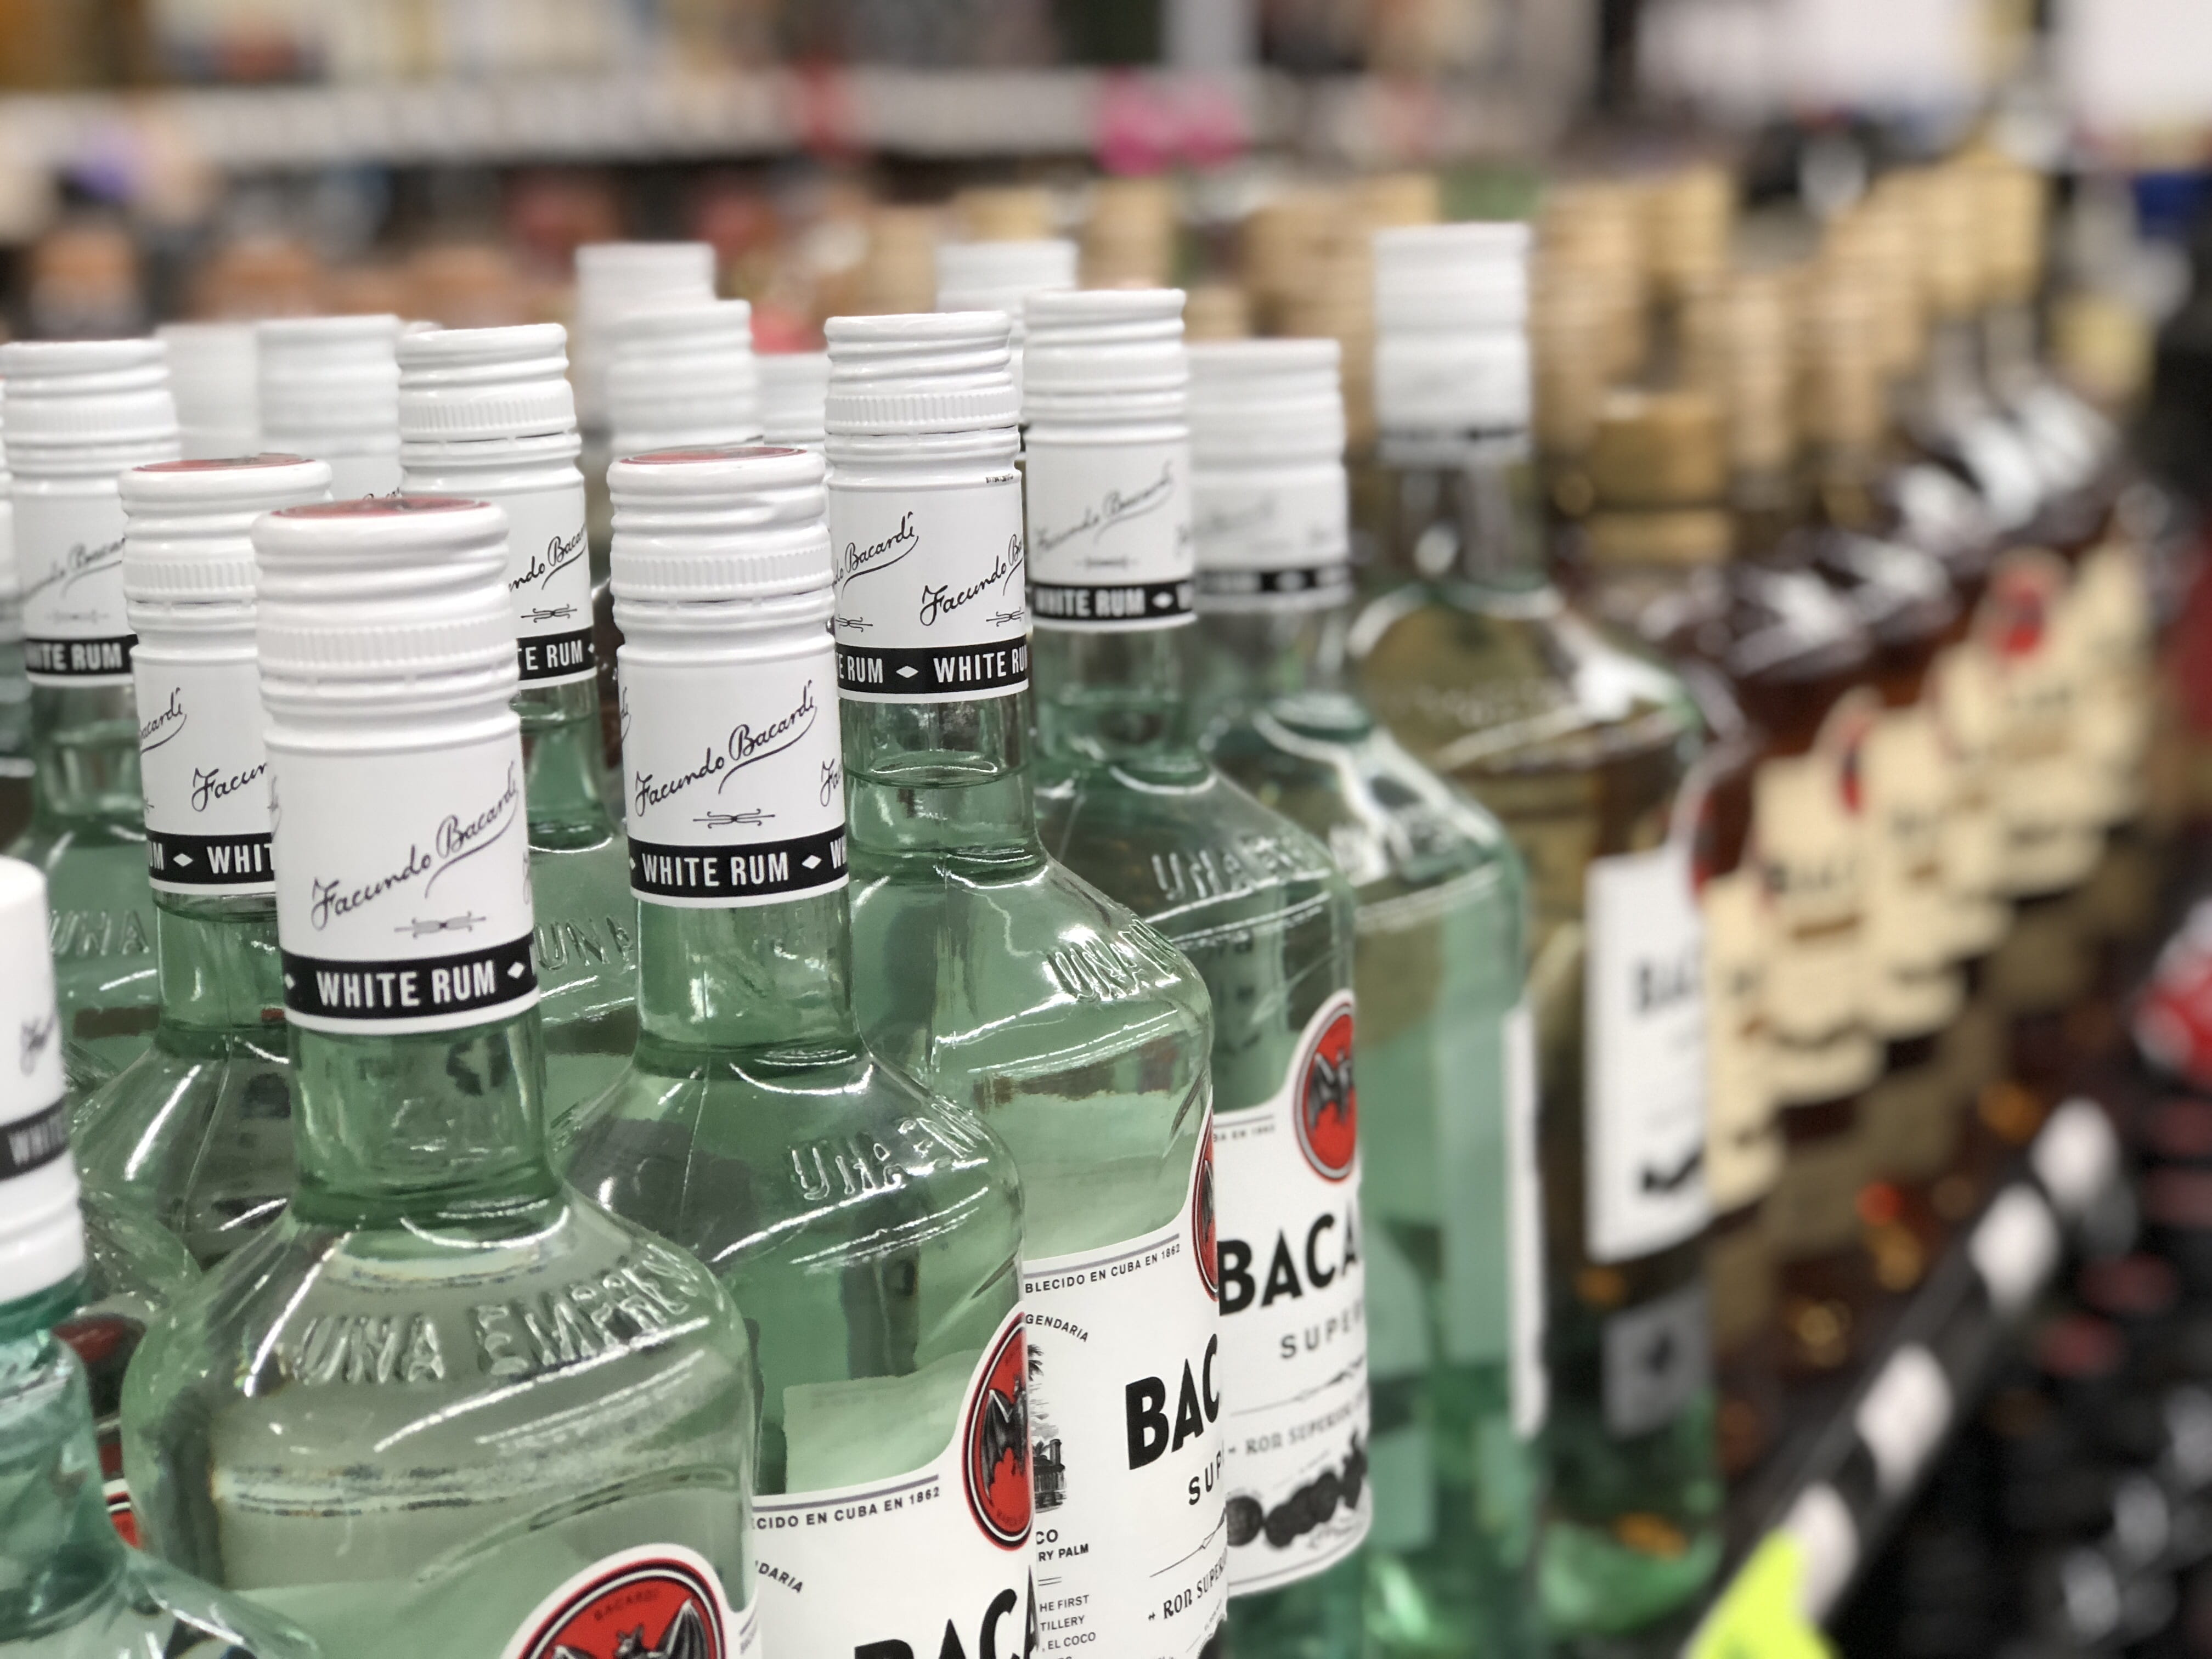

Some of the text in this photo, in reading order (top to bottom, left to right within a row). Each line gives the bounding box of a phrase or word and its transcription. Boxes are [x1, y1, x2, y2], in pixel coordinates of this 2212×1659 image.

[919, 555, 1007, 627] Facundo
[1095, 587, 1146, 617] RUM
[70, 642, 122, 670] RUM
[546, 639, 583, 669] RUM
[847, 656, 883, 684] RUM
[933, 651, 1007, 684] WHITE
[635, 747, 725, 816] Facundo
[206, 843, 275, 874] WHIT
[642, 851, 789, 887] WHITE RUM
[311, 844, 431, 930] Facundo
[317, 960, 495, 1008] WHITE RUM
[1025, 1243, 1181, 1294] BLECIDO EN CUBA EN 1862
[1025, 1313, 1089, 1342] GENDARIA
[1125, 1333, 1218, 1471] BAC
[1188, 1448, 1223, 1505] SUP
[756, 1486, 940, 1530] CIDO EN CUBA EN 1862
[1058, 1543, 1089, 1559] PALM
[756, 1561, 803, 1593] DARIA
[1057, 1594, 1090, 1610] FIRST
[1040, 1615, 1085, 1632] TILLERY
[1048, 1632, 1096, 1650] EL COCO
